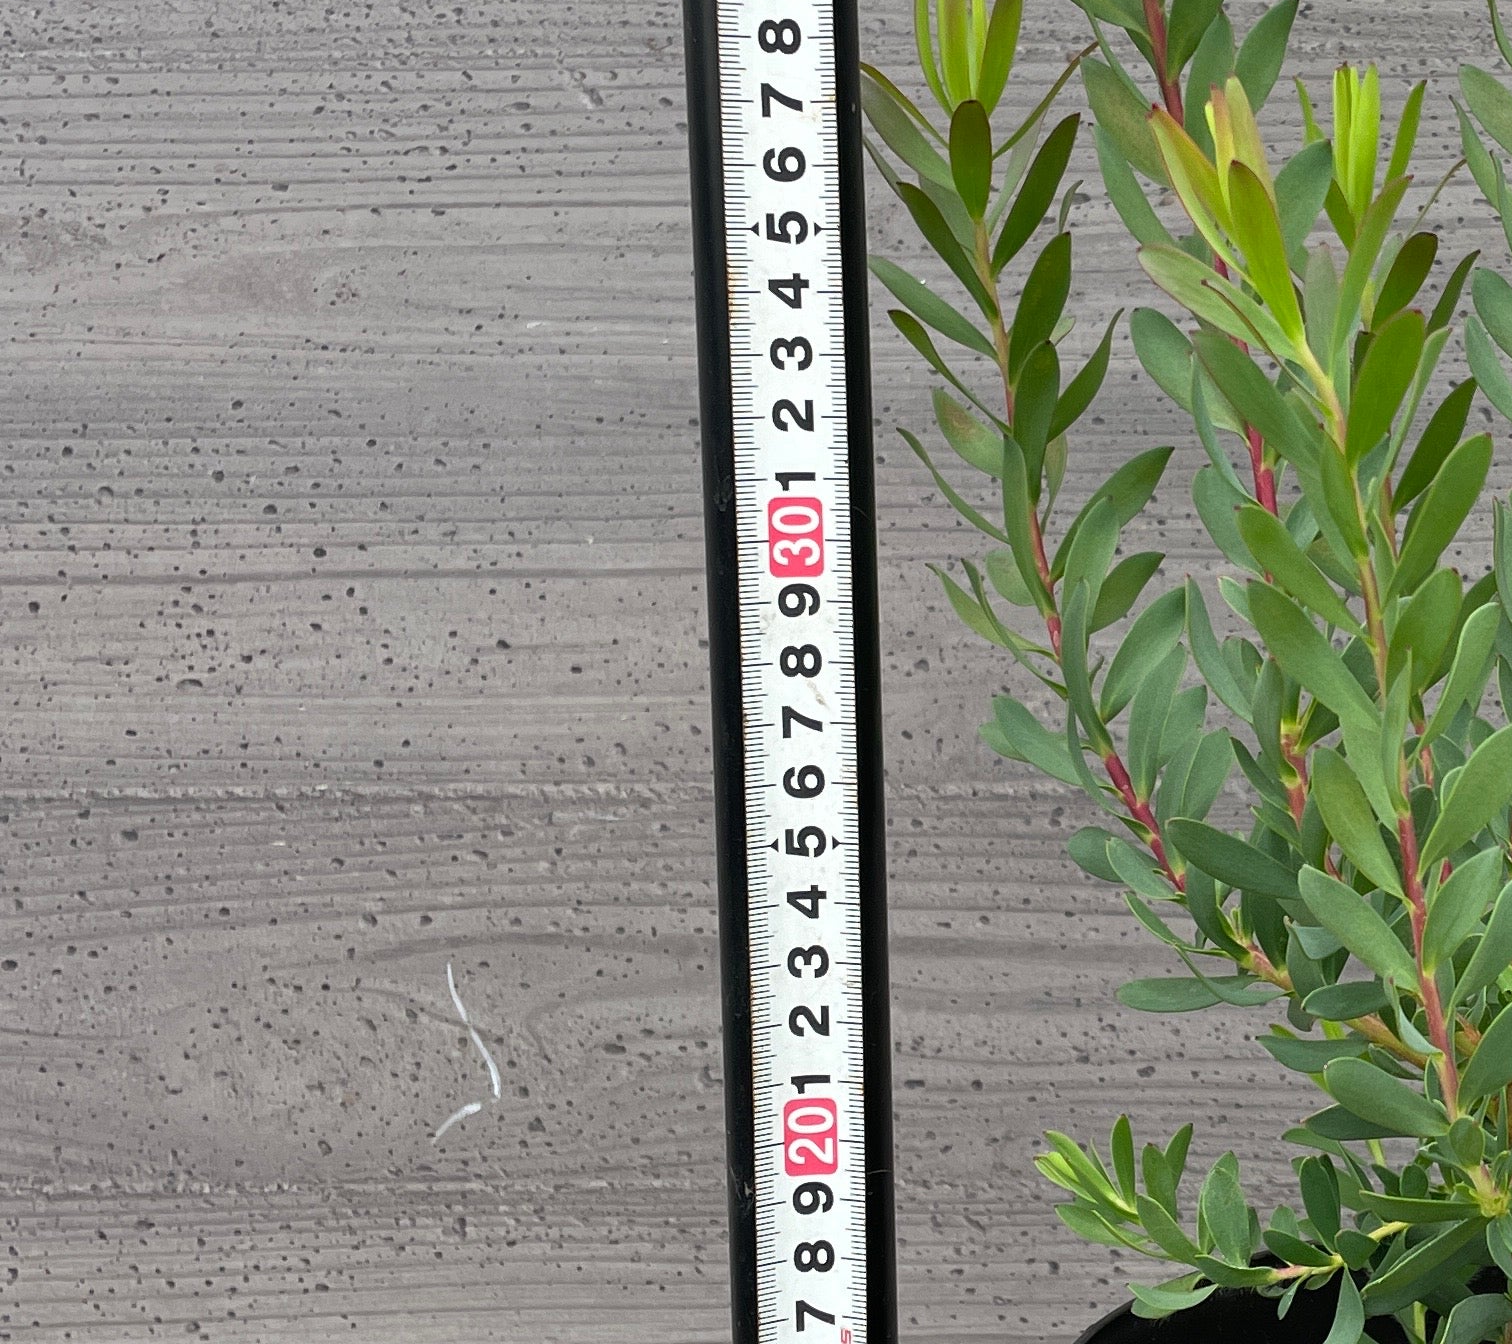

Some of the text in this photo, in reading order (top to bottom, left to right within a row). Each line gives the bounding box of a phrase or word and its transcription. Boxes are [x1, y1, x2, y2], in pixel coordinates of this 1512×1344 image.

[757, 18, 802, 55] 8
[760, 82, 804, 118] 7
[762, 146, 806, 183] 6
[765, 210, 809, 245] 5
[767, 272, 810, 309] 4
[769, 336, 813, 371] 3
[771, 398, 815, 433] 2
[774, 471, 816, 492] 1
[772, 506, 820, 565] 30
[777, 583, 821, 618] 9
[779, 643, 823, 679] 8
[781, 705, 823, 739] 7
[782, 764, 826, 799] 6
[784, 825, 827, 858] 5
[786, 884, 827, 920] 4
[787, 944, 830, 979] 3
[788, 1005, 830, 1037] 2
[790, 1074, 831, 1095] 1
[788, 1107, 834, 1163] 20
[792, 1181, 834, 1215] 9
[793, 1239, 835, 1273] 8
[795, 1299, 836, 1333] 7
